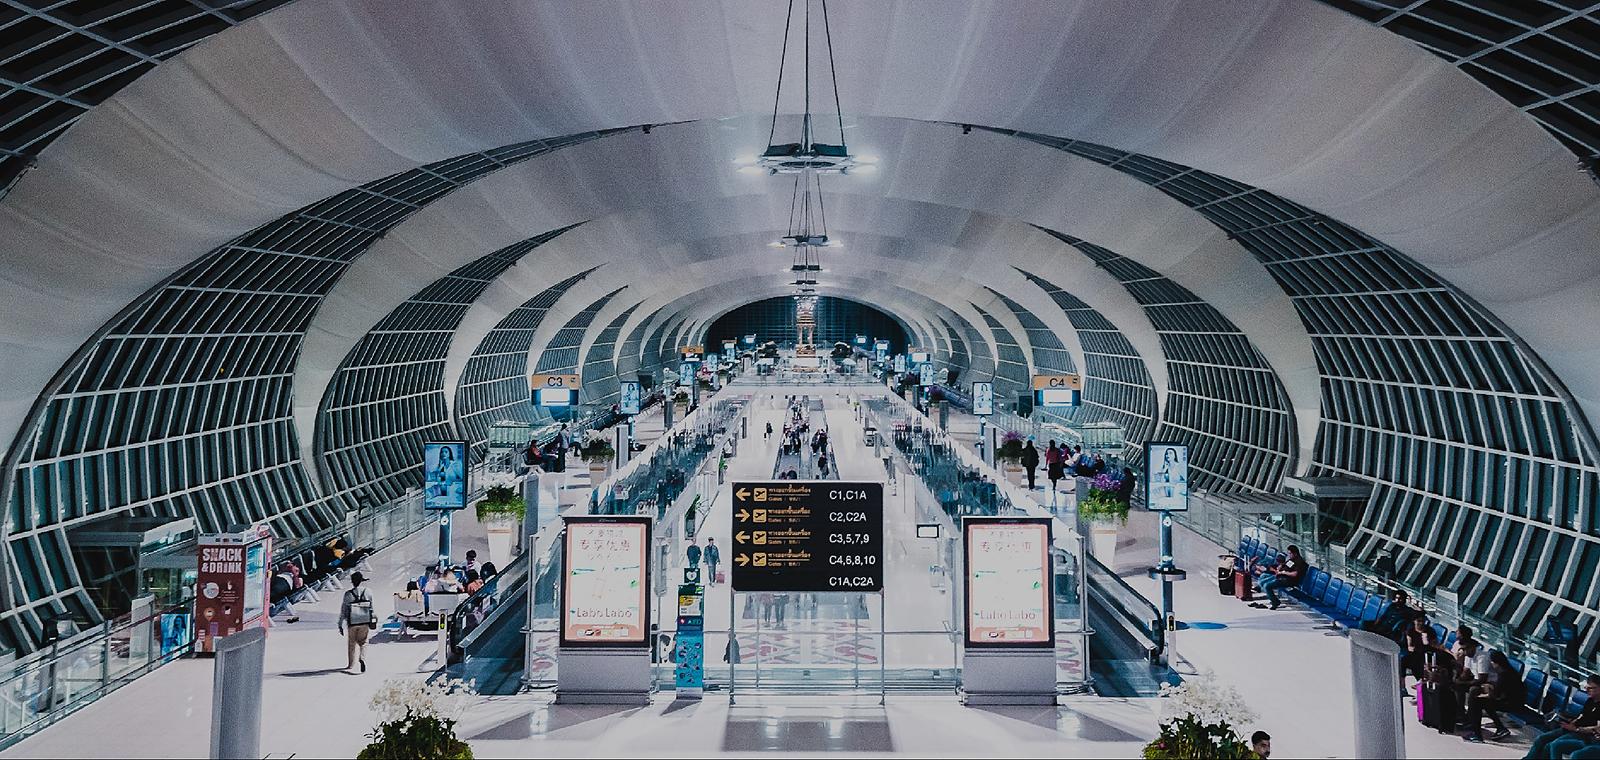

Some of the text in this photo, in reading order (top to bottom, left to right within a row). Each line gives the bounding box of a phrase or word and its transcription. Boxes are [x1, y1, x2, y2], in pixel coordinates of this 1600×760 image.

[547, 376, 563, 387] C3
[1049, 378, 1065, 387] C4
[829, 490, 867, 501] C1,C1A
[829, 512, 867, 522] C2,C2A
[829, 533, 870, 544] C3,5,7,9
[202, 548, 242, 562] SNACK
[829, 555, 876, 566] C4,6,8,10
[829, 577, 874, 587] C1A,C2A
